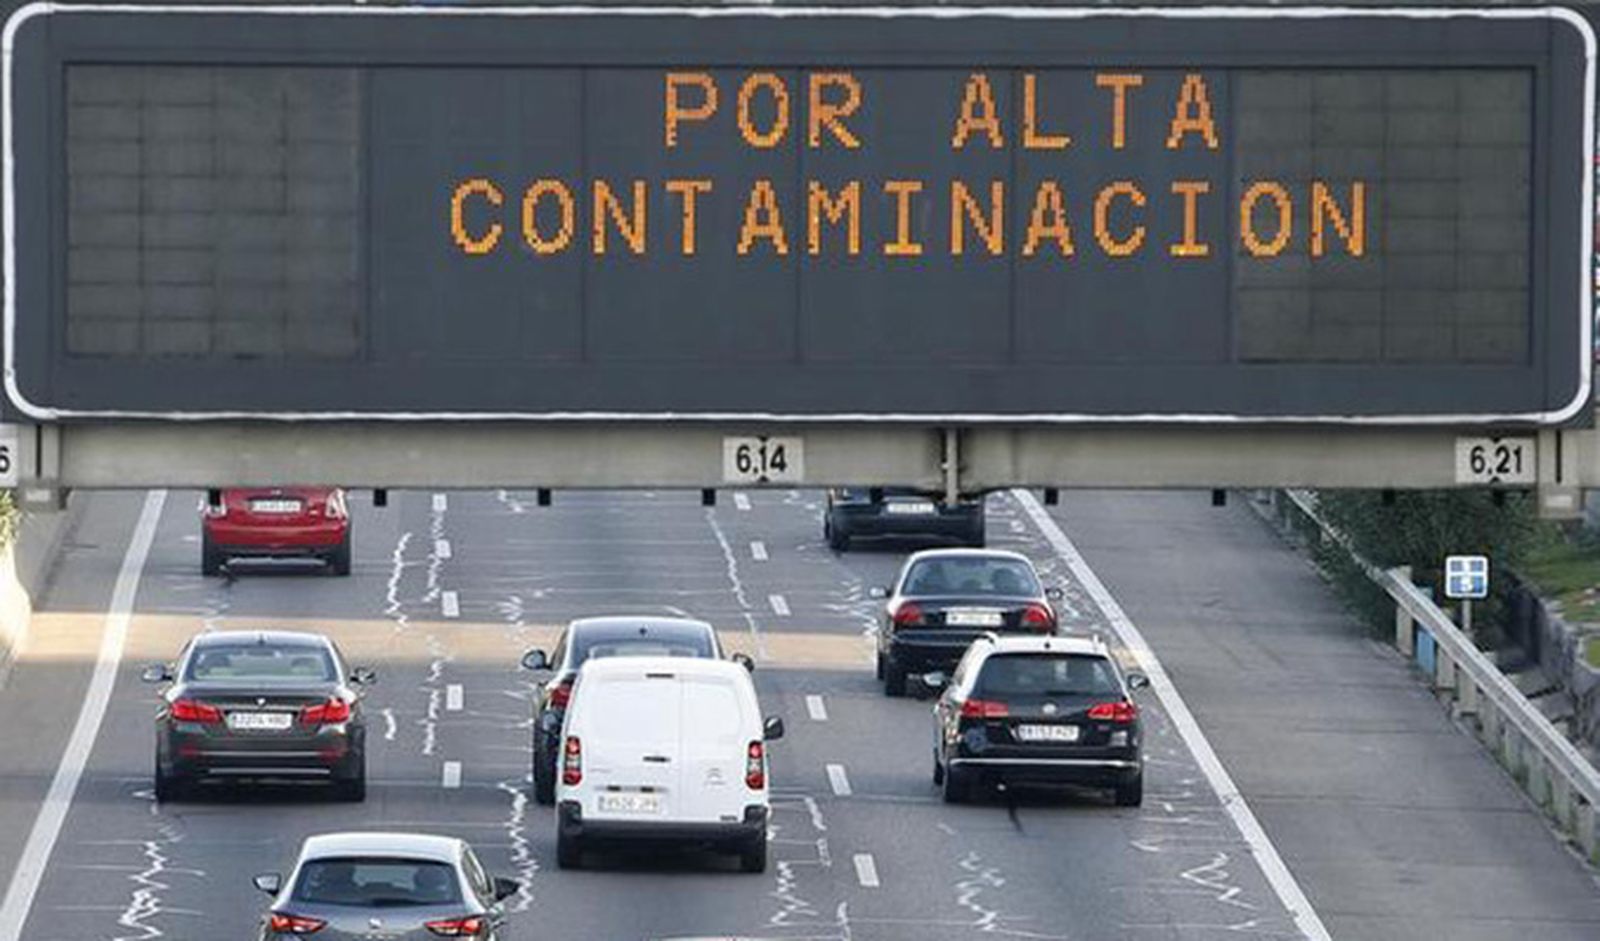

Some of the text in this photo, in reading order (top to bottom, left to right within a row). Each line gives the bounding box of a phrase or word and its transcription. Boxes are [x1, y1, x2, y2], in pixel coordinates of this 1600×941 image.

[664, 71, 1220, 149] POR ALTA
[450, 179, 1366, 256] CONTAMINACION
[736, 444, 787, 473] 6.14
[1470, 445, 1522, 475] 6.21
